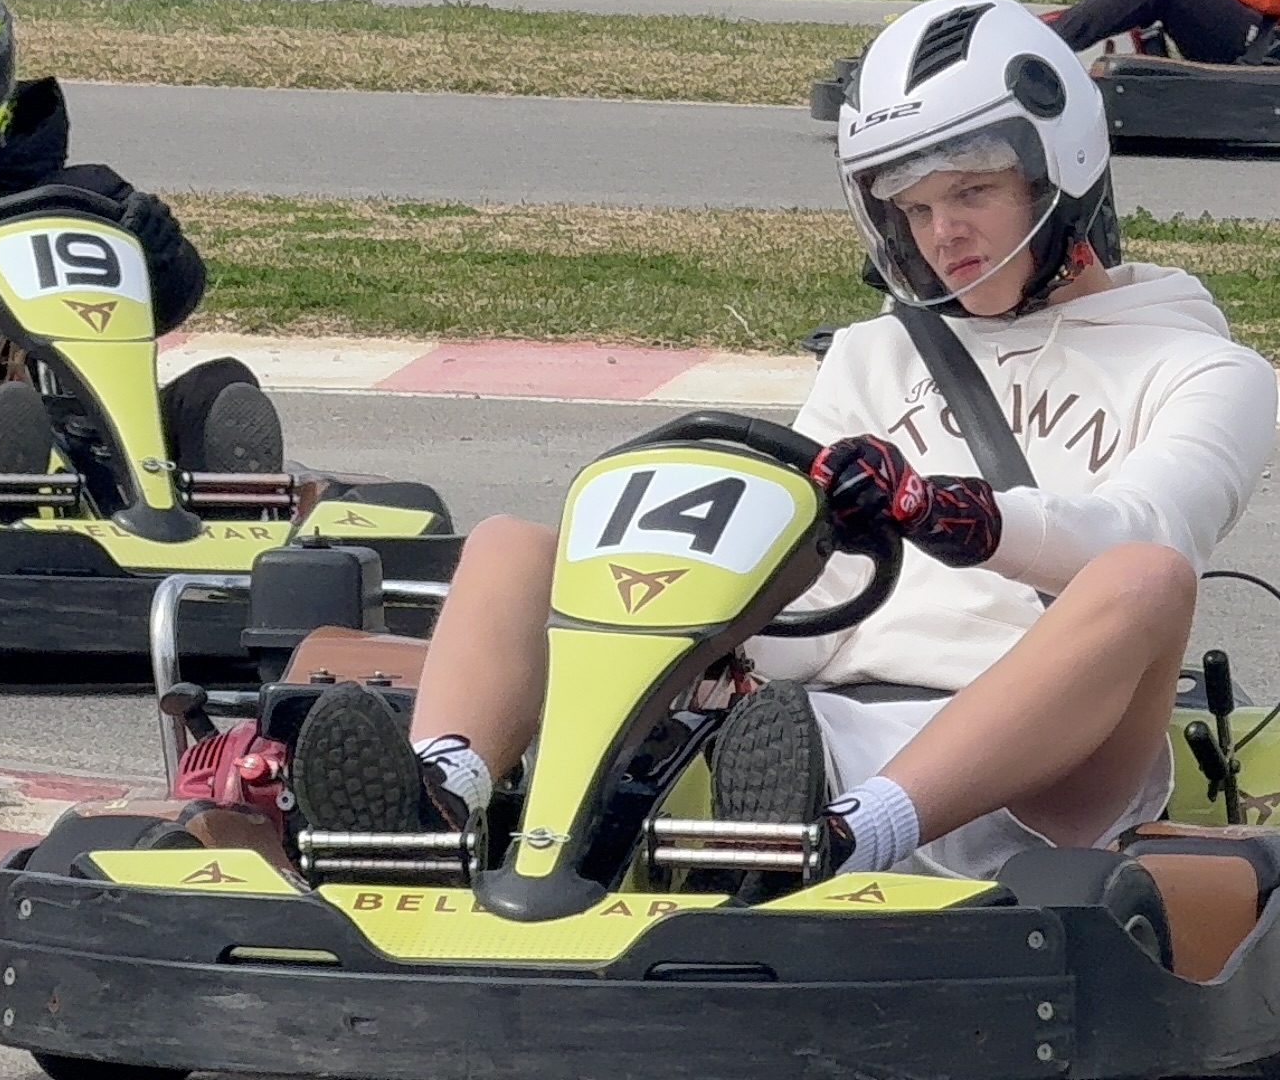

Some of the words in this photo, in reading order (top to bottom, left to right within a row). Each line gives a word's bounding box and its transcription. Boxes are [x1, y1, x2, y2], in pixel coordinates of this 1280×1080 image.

[850, 101, 923, 137] LS2
[30, 232, 121, 290] 19
[595, 470, 747, 555] 14
